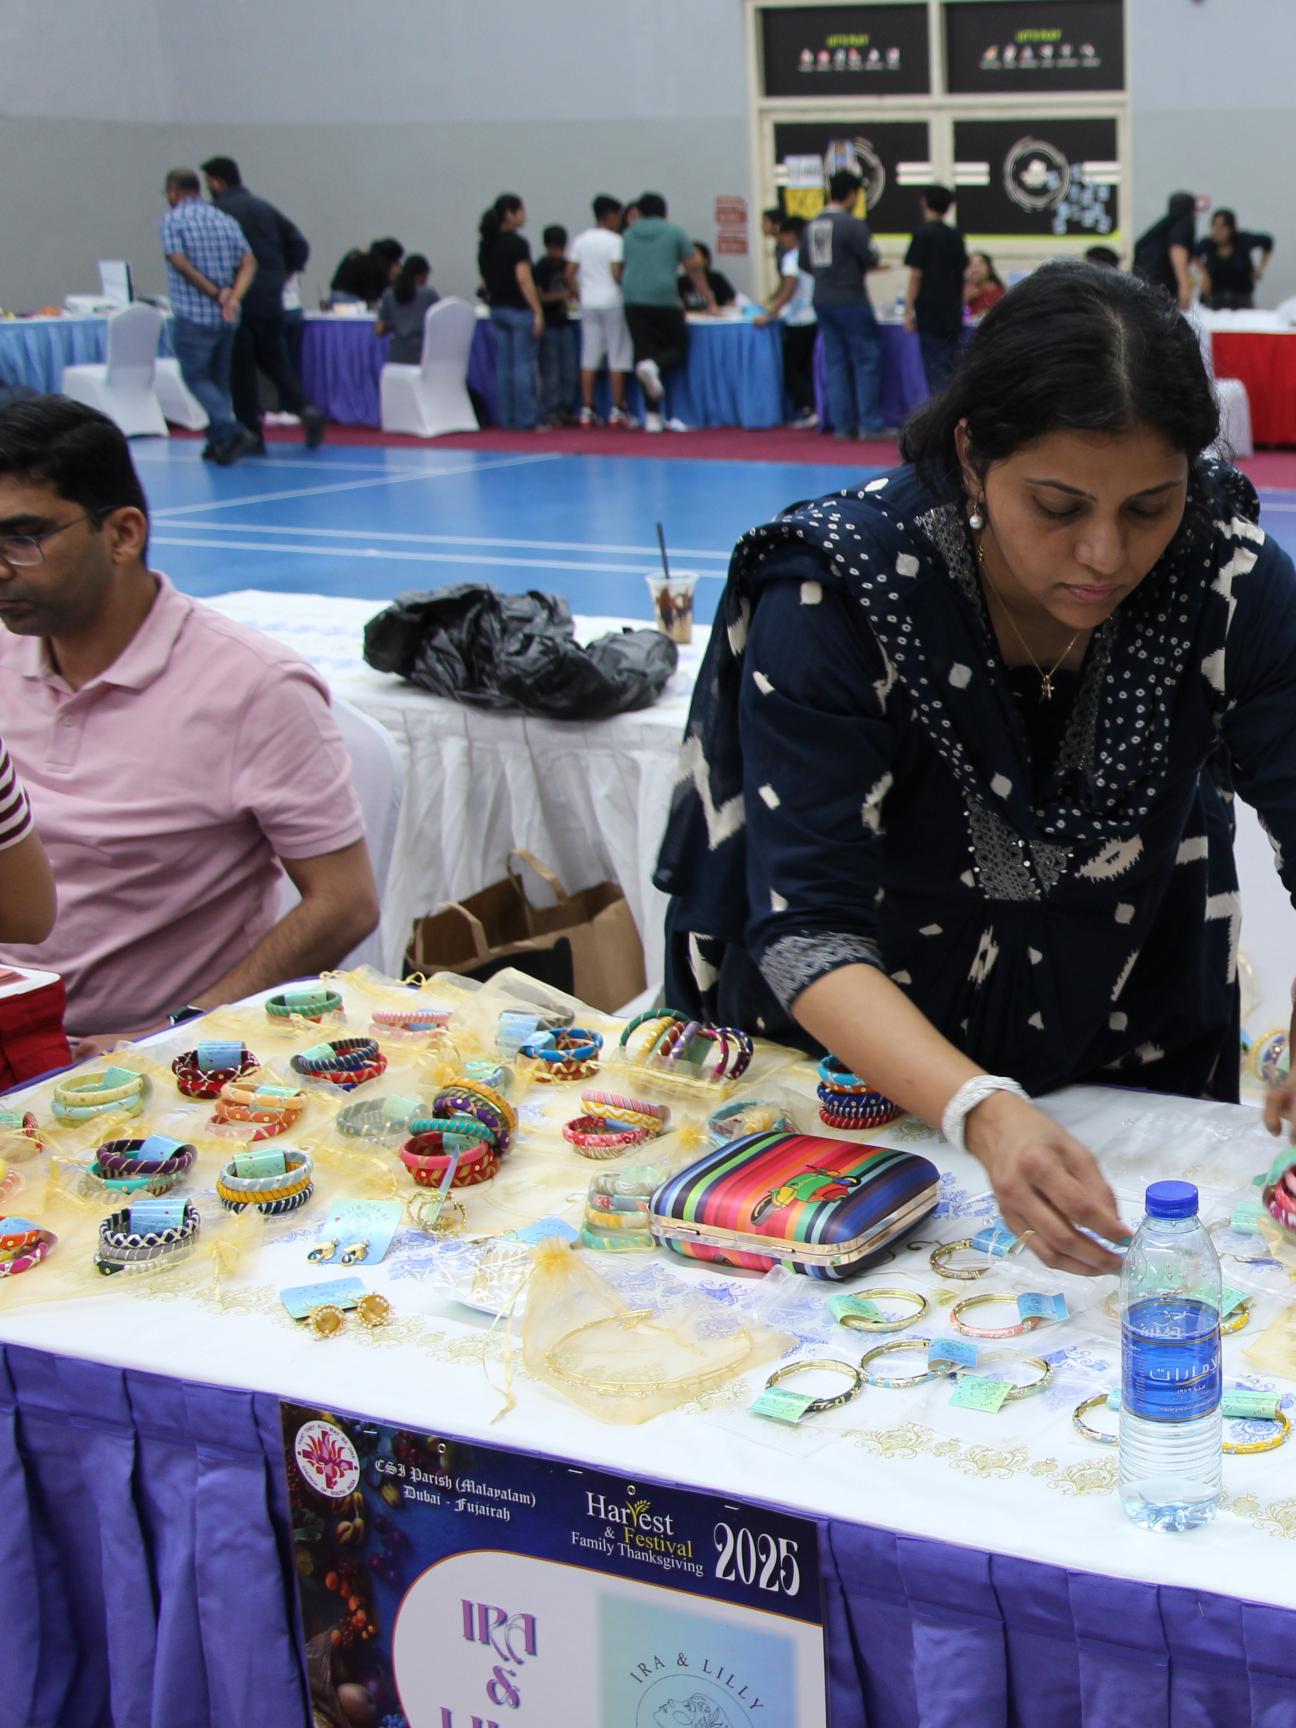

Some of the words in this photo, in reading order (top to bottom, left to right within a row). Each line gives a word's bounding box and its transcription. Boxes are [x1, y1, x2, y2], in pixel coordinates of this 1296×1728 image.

[374, 1459, 406, 1477] CSI
[410, 1466, 452, 1490] Parish
[455, 1477, 536, 1507] (Malayalam)
[403, 1485, 441, 1506] Dubai
[454, 1498, 511, 1522] Fujairah
[585, 1491, 675, 1536] Harvest
[571, 1531, 615, 1556] Family
[617, 1542, 704, 1577] Thanksgiving
[604, 1526, 616, 1539] &
[623, 1526, 694, 1558] Festival
[713, 1522, 800, 1596] 2025
[460, 1598, 538, 1665] IRA
[486, 1665, 521, 1710] &
[629, 1655, 666, 1684] IRA
[676, 1652, 689, 1668] &
[702, 1659, 765, 1711] LILLY
